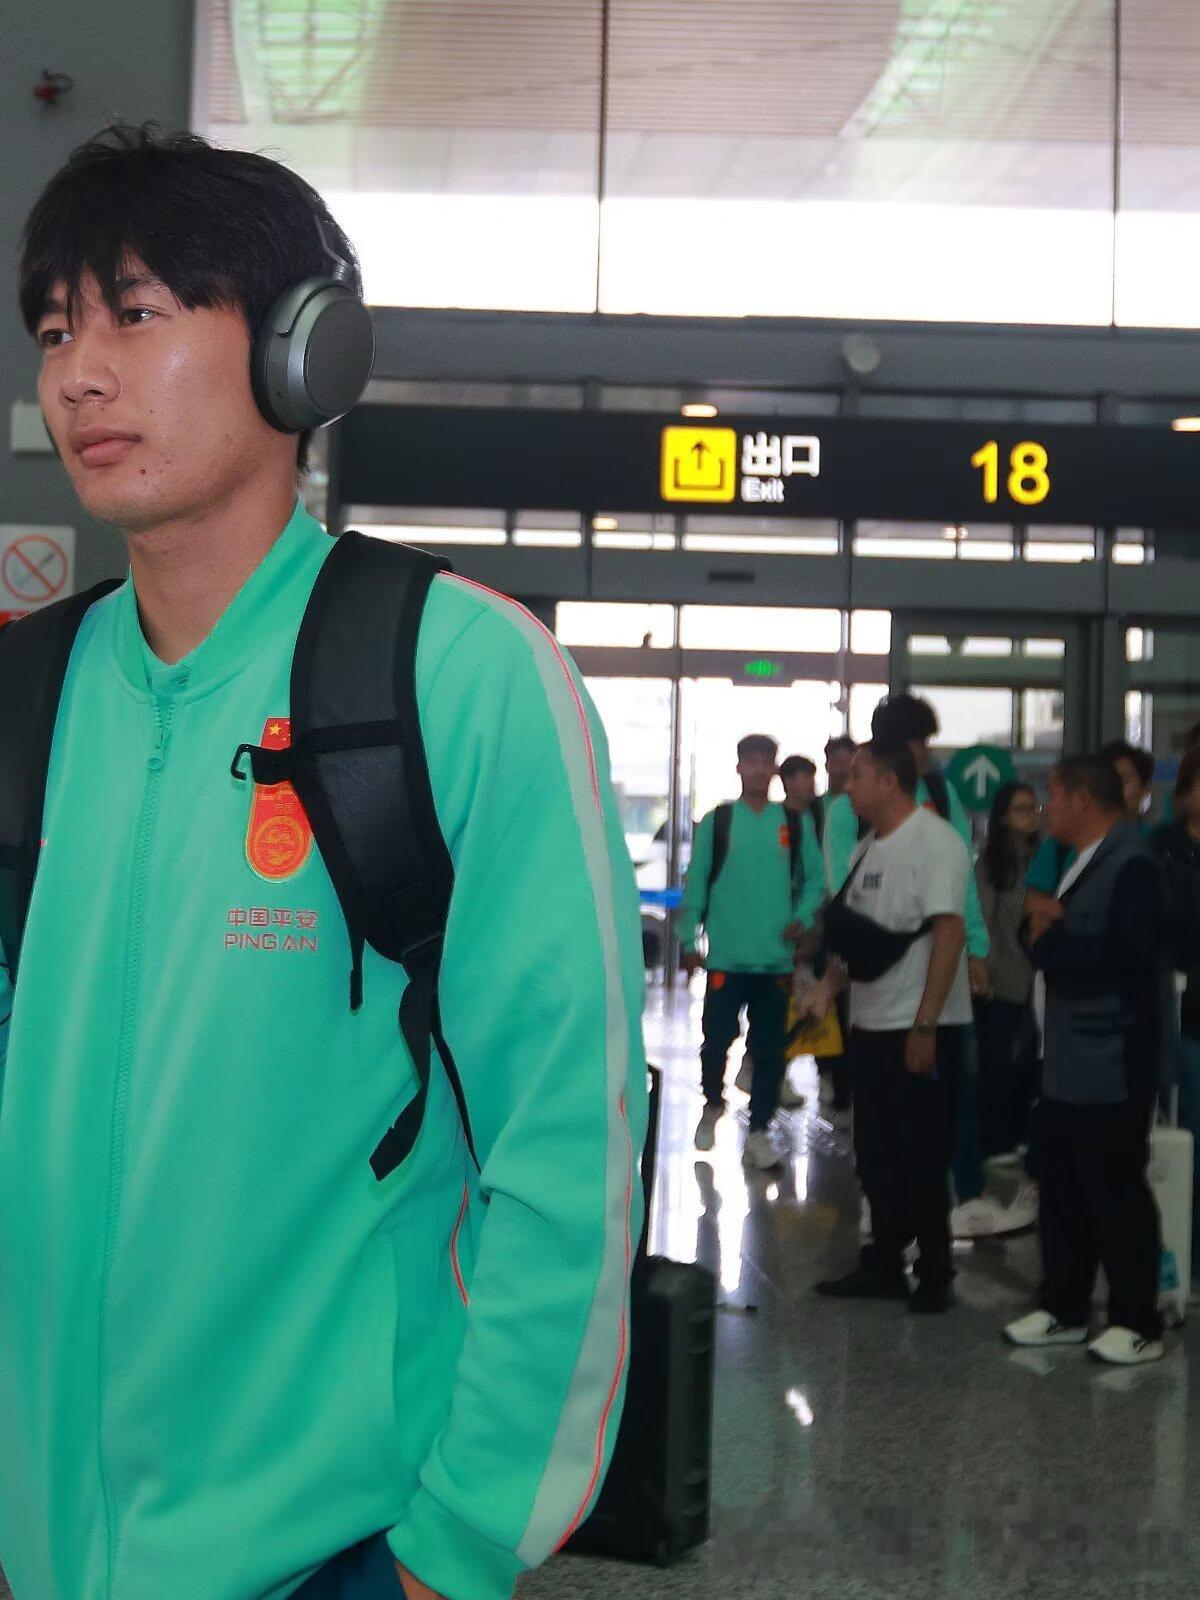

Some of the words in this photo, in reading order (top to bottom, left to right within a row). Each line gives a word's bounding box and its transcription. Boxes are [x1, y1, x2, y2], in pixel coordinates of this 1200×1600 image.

[742, 431, 820, 477] 出口
[741, 476, 785, 503] Exit
[970, 440, 1050, 505] 18
[227, 907, 318, 929] 中国平安
